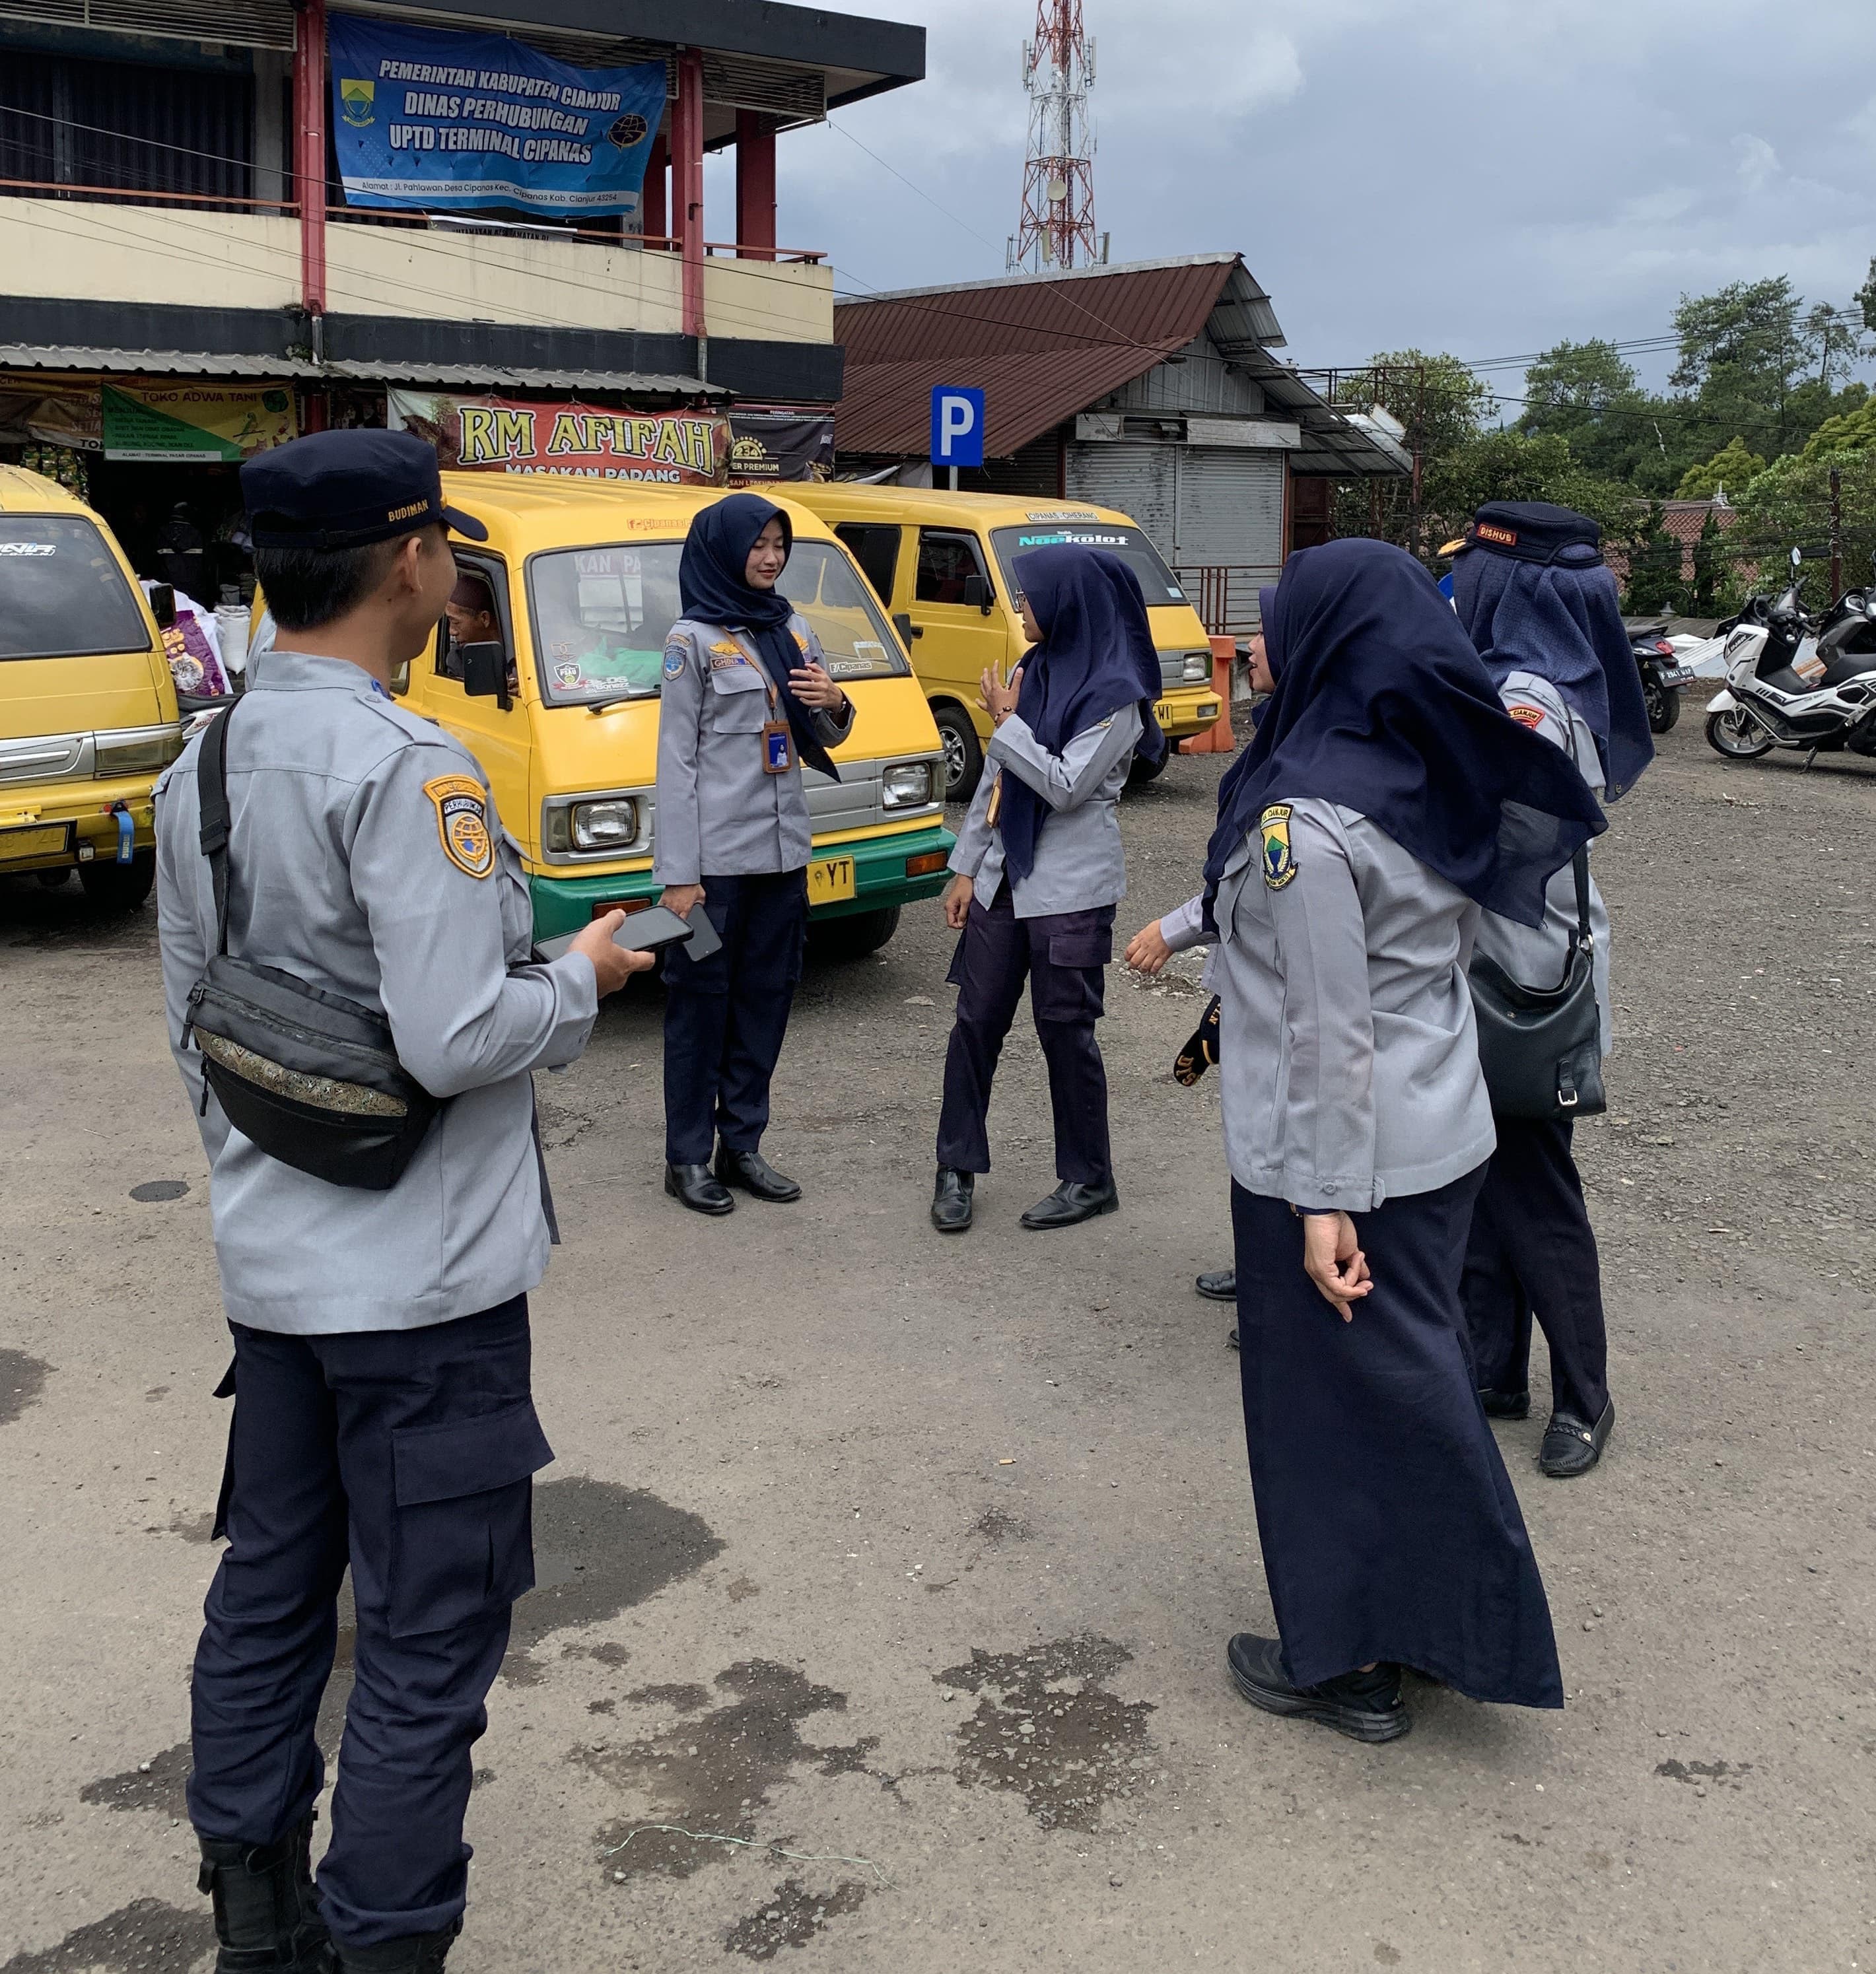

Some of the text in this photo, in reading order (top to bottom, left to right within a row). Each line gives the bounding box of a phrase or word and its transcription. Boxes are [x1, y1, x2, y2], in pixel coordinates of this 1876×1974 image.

[379, 59, 621, 111] PEMERINTAH KABUPATEN CIANJUR
[404, 91, 590, 135] DINAS PERHUBUNGAN
[389, 124, 592, 164] UPTD TERMINAL CIPANAS
[363, 182, 388, 191] Alamat
[464, 184, 493, 193] Cipanas
[514, 187, 548, 201] Cipanas
[570, 195, 596, 204] Cianjur
[141, 391, 257, 402] TOKO ADWA TANI
[940, 395, 975, 456] P
[458, 407, 713, 475] RM AFIFAH
[736, 446, 758, 456] 234
[606, 468, 681, 483] PADANG
[744, 463, 779, 471] PREMIUM
[388, 499, 429, 522] BUDIMAN
[1480, 527, 1512, 541] DISHUB
[829, 662, 872, 673] F/Cipanas
[1158, 705, 1169, 720] WI
[826, 860, 850, 887] YT
